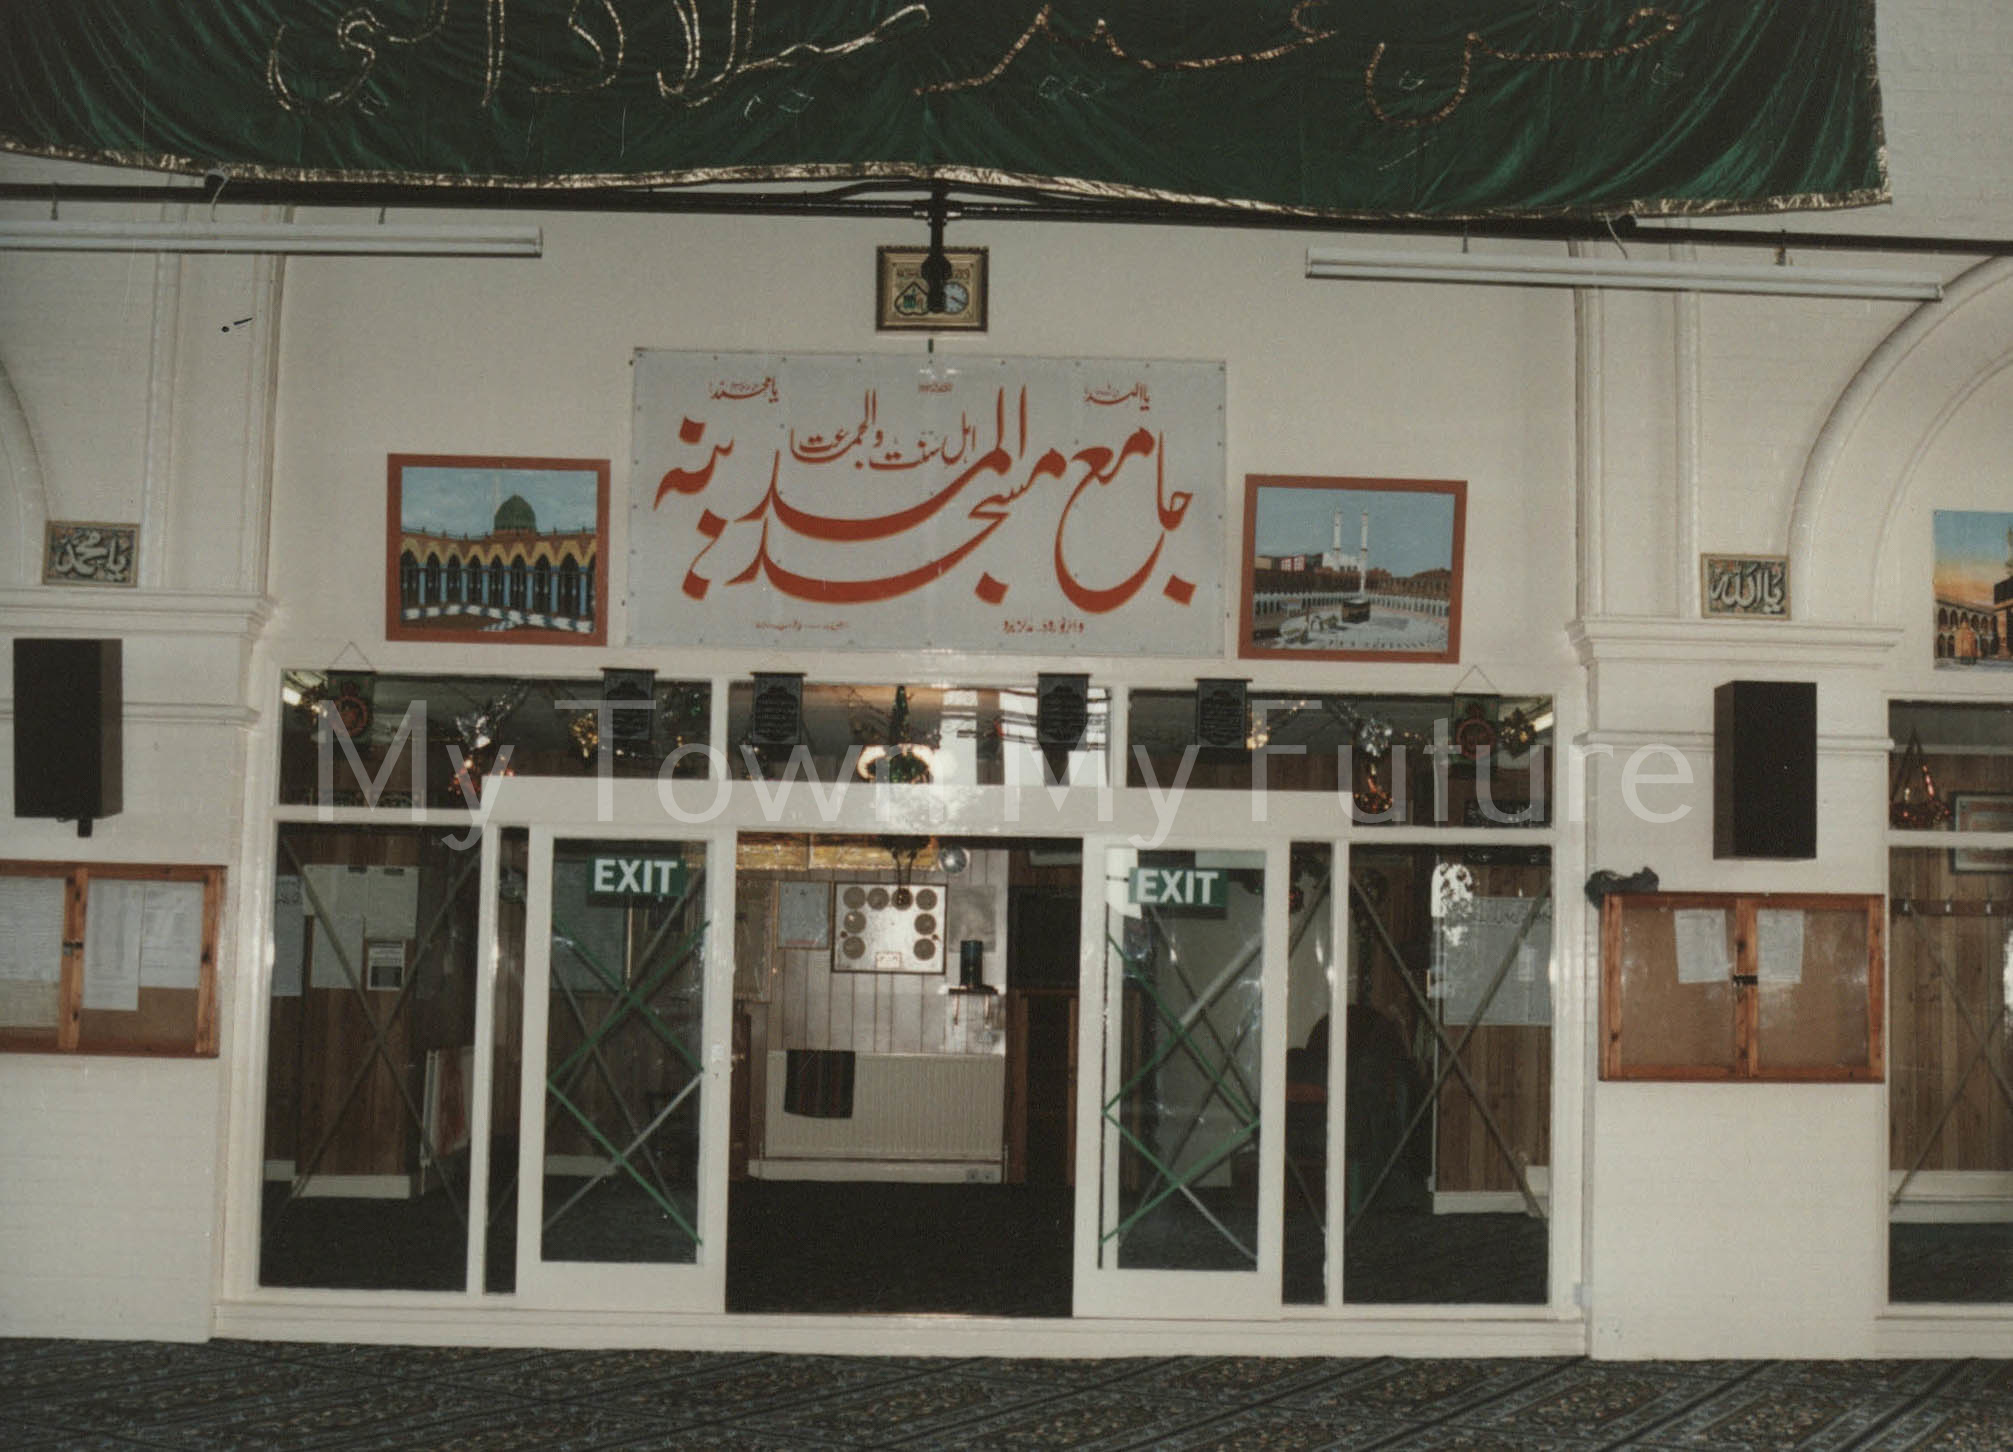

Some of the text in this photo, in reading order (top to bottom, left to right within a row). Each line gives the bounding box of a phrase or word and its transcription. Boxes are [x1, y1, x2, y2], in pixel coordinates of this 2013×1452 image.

[722, 446, 1067, 605] مسجد
[1054, 425, 1197, 615] جامع
[594, 857, 678, 893] EXIT
[1136, 868, 1219, 905] EXIT
